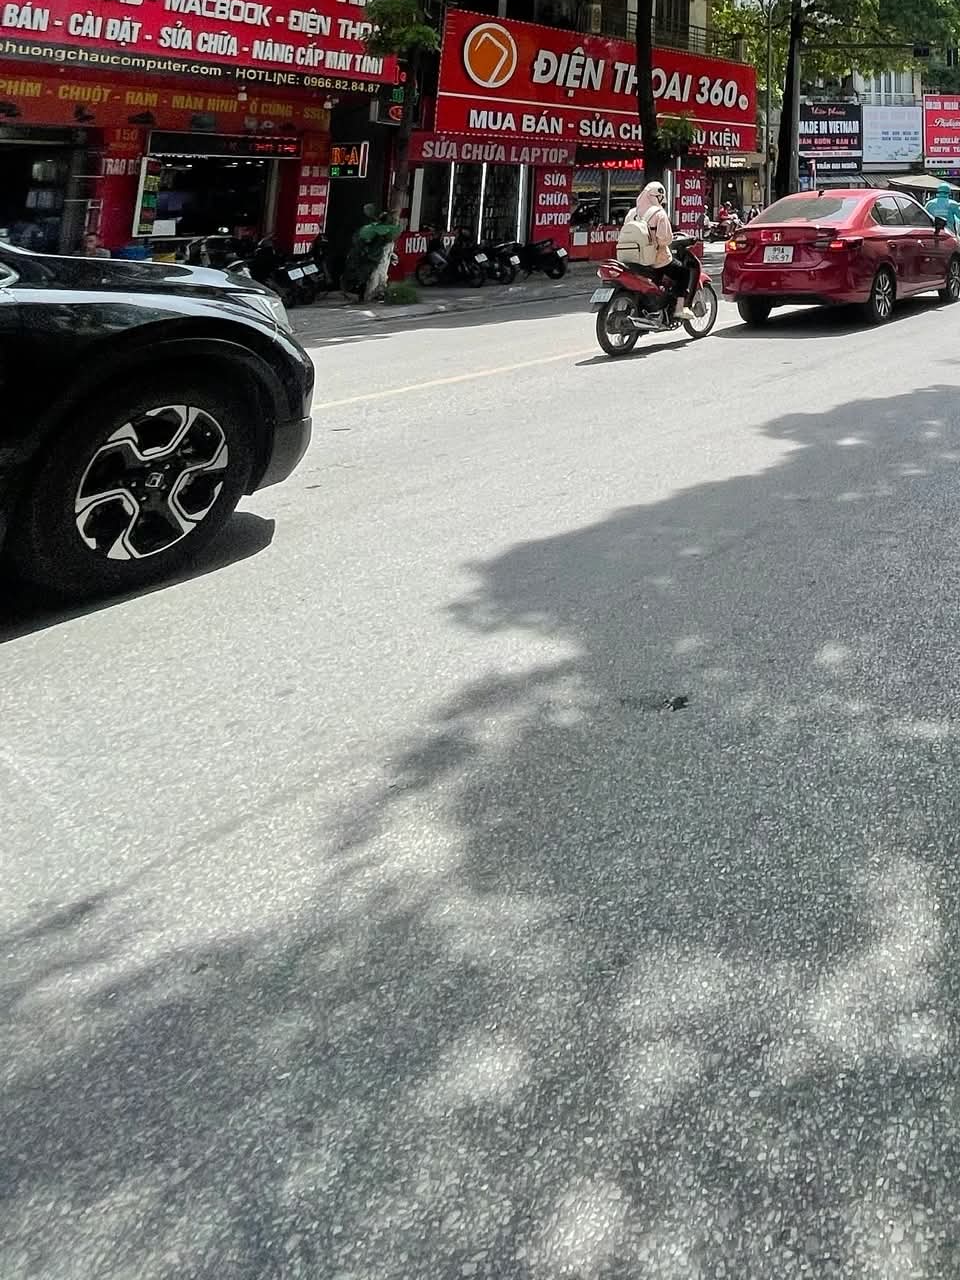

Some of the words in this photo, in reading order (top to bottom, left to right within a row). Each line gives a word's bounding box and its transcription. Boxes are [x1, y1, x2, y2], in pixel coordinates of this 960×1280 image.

[288, 7, 332, 38] ĐIỆN
[2, 1, 50, 32] BÁN
[69, 10, 102, 38] CÀI
[105, 15, 142, 47] ĐẶT
[158, 20, 193, 51] SỬA
[196, 31, 238, 57] CHỮA
[252, 38, 294, 64] NÂNG
[295, 42, 325, 67] CẤP
[235, 68, 300, 86] HOTLINE:
[303, 76, 381, 94] 0966.82.84.87
[532, 46, 605, 97] ĐIỆN
[695, 76, 738, 109] 360
[126, 90, 159, 107] RAM
[469, 109, 516, 132] MUA
[521, 108, 563, 135] BÁN
[579, 112, 615, 139] SỬA
[709, 127, 741, 151] KIỆN
[799, 121, 819, 134] MADE
[819, 121, 828, 134] IN
[829, 121, 860, 134] VIETNAM
[421, 135, 458, 160] SỬA
[461, 140, 506, 162] CHỮA
[511, 147, 569, 164] LAPTOP
[543, 170, 567, 186] SỬA
[684, 176, 702, 190] SỬA
[538, 192, 569, 206] CHỮA
[681, 194, 703, 207] CHỮA
[535, 212, 571, 226] LAPTOP
[405, 233, 428, 254] HỮA
